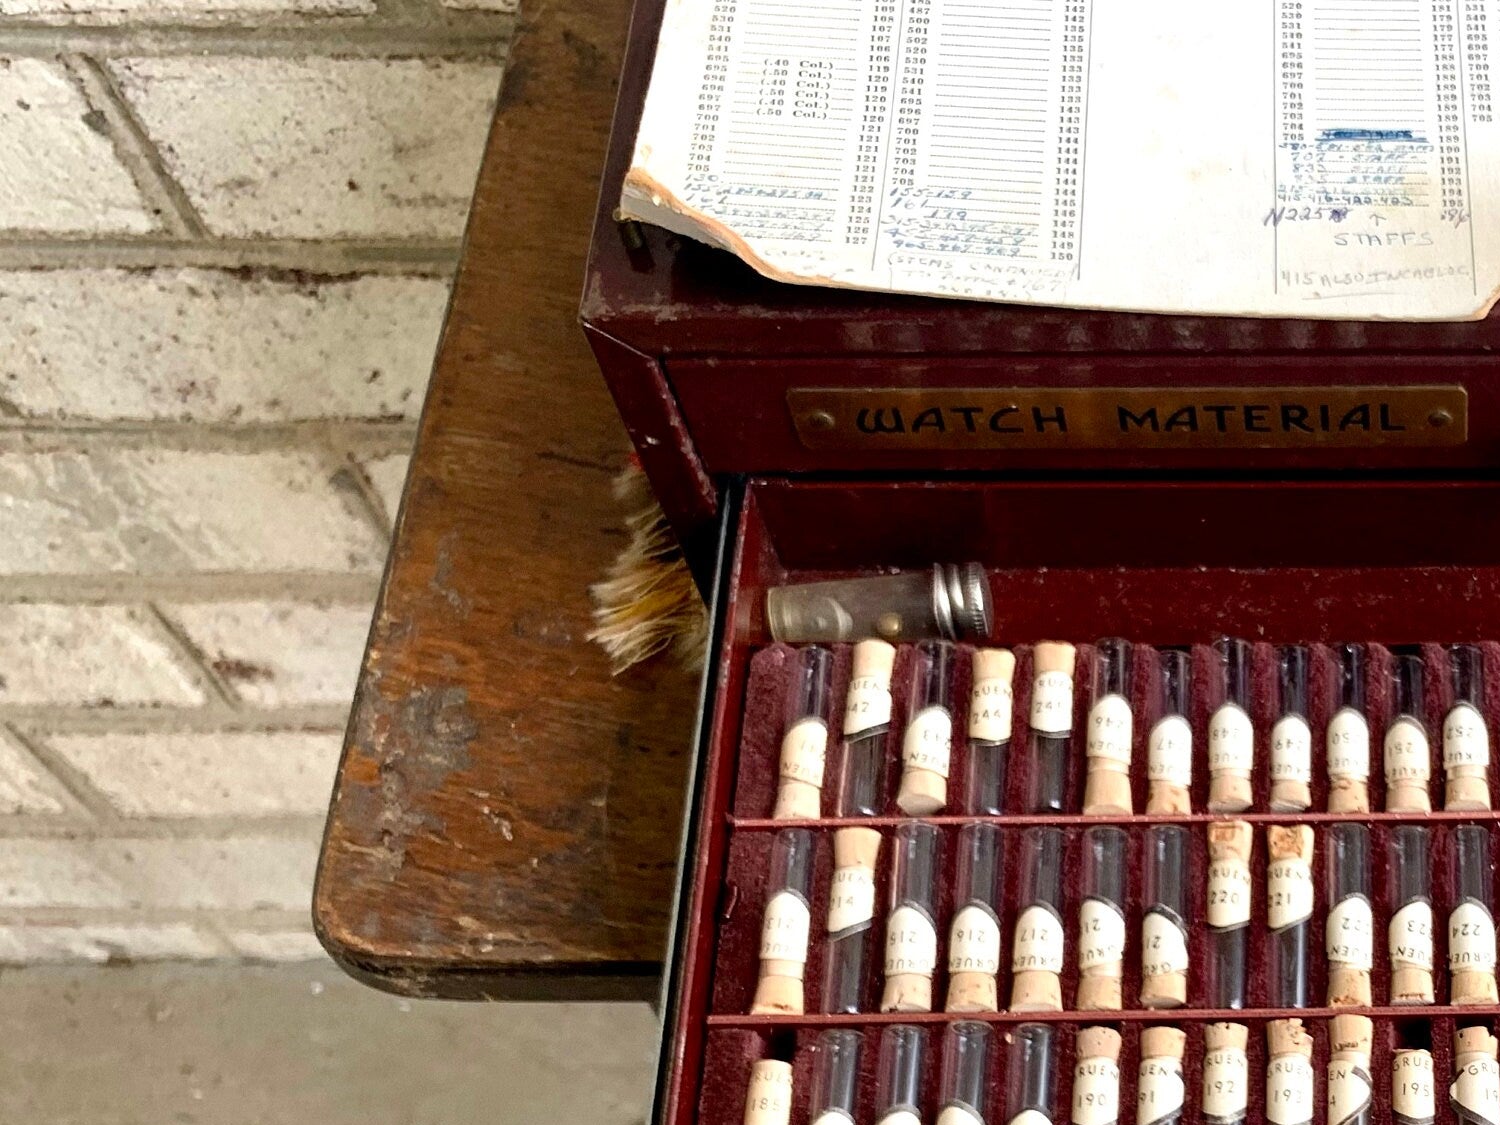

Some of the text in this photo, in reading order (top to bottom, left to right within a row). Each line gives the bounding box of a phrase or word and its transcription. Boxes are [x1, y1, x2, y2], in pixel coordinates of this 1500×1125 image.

[705, 64, 728, 72] 695
[799, 70, 832, 81] Col.)
[867, 75, 889, 83] 120
[707, 55, 730, 63] 695
[800, 60, 833, 70] Col.)
[869, 65, 890, 74] 119
[703, 74, 726, 82] 696
[796, 80, 830, 90] Col.)
[866, 85, 888, 93] 119
[701, 84, 725, 92] 696
[795, 90, 830, 100] Col.)
[864, 95, 886, 103] 120
[1334, 231, 1434, 246] STAFFS
[855, 403, 1405, 434] WATCH MATERIAL
